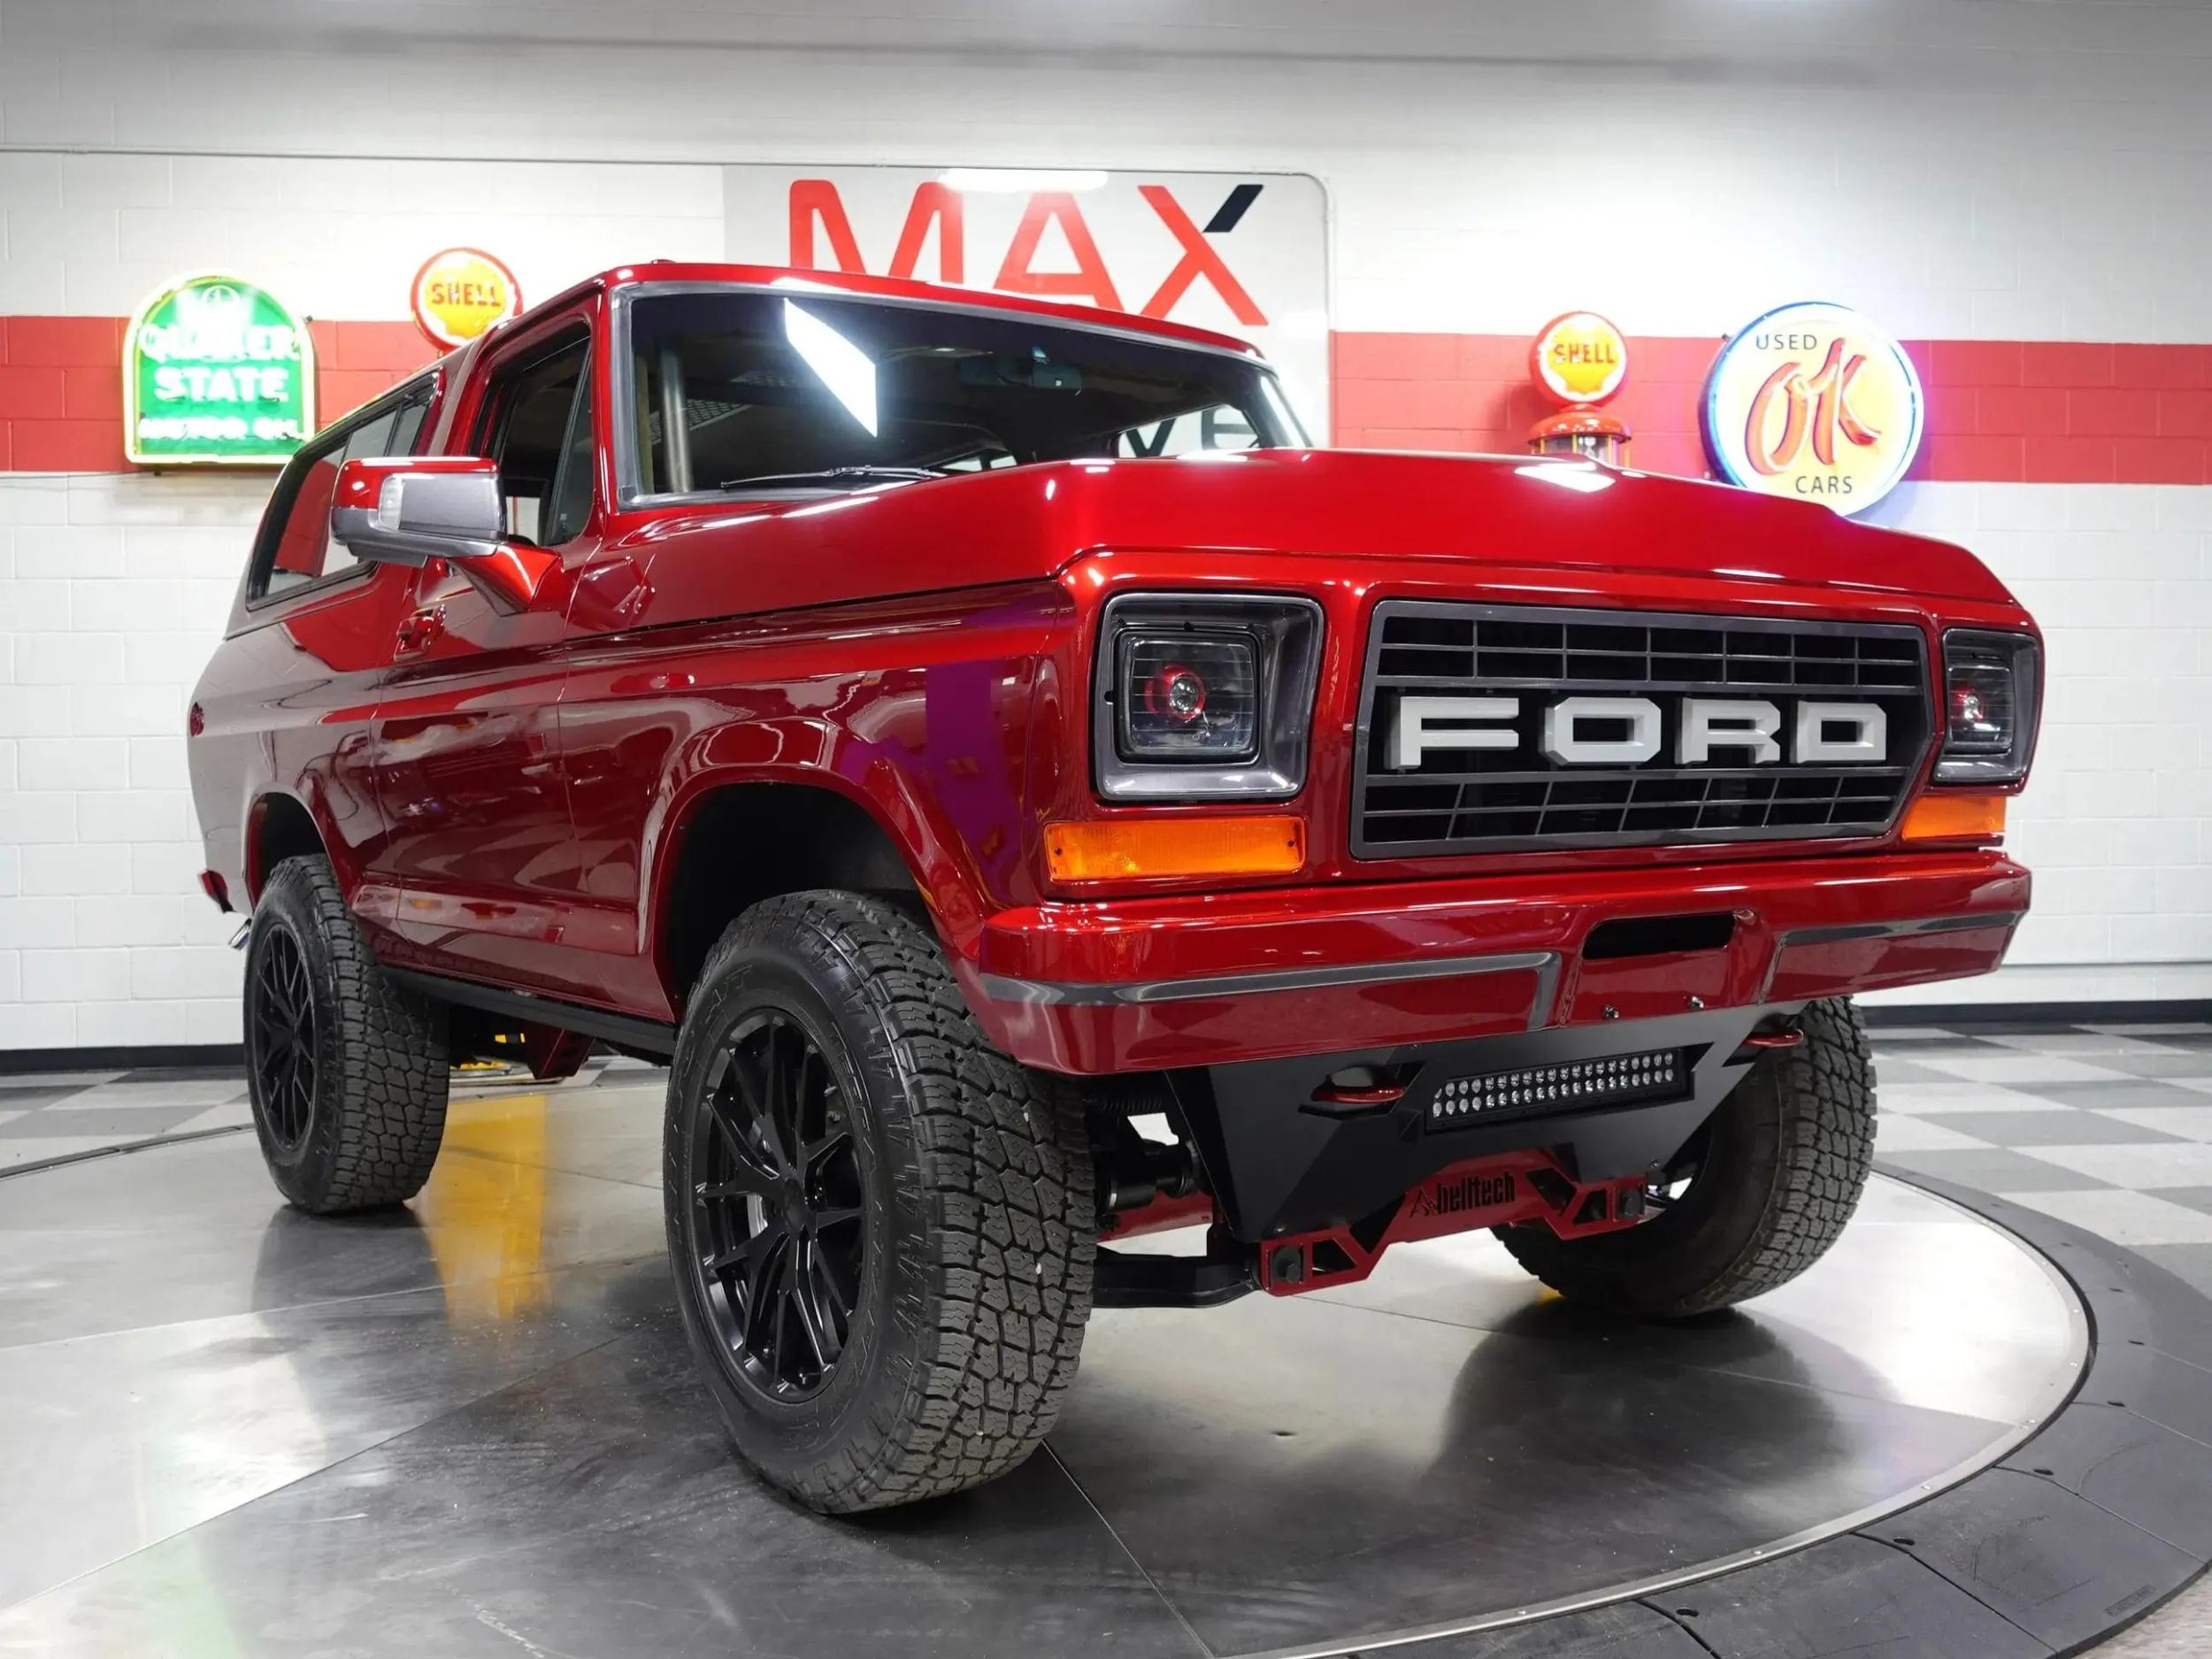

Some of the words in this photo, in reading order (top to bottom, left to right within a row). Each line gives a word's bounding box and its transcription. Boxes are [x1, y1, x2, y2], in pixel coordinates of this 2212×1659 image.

[789, 179, 1269, 326] MAX
[431, 282, 502, 307] SHELL
[138, 324, 300, 363] QUER
[1554, 342, 1615, 365] SHELL
[1755, 334, 1817, 350] USED
[154, 366, 289, 403] STATE
[1745, 337, 1882, 476] OK
[1795, 476, 1853, 494] CARS
[1385, 695, 1887, 771] FORD
